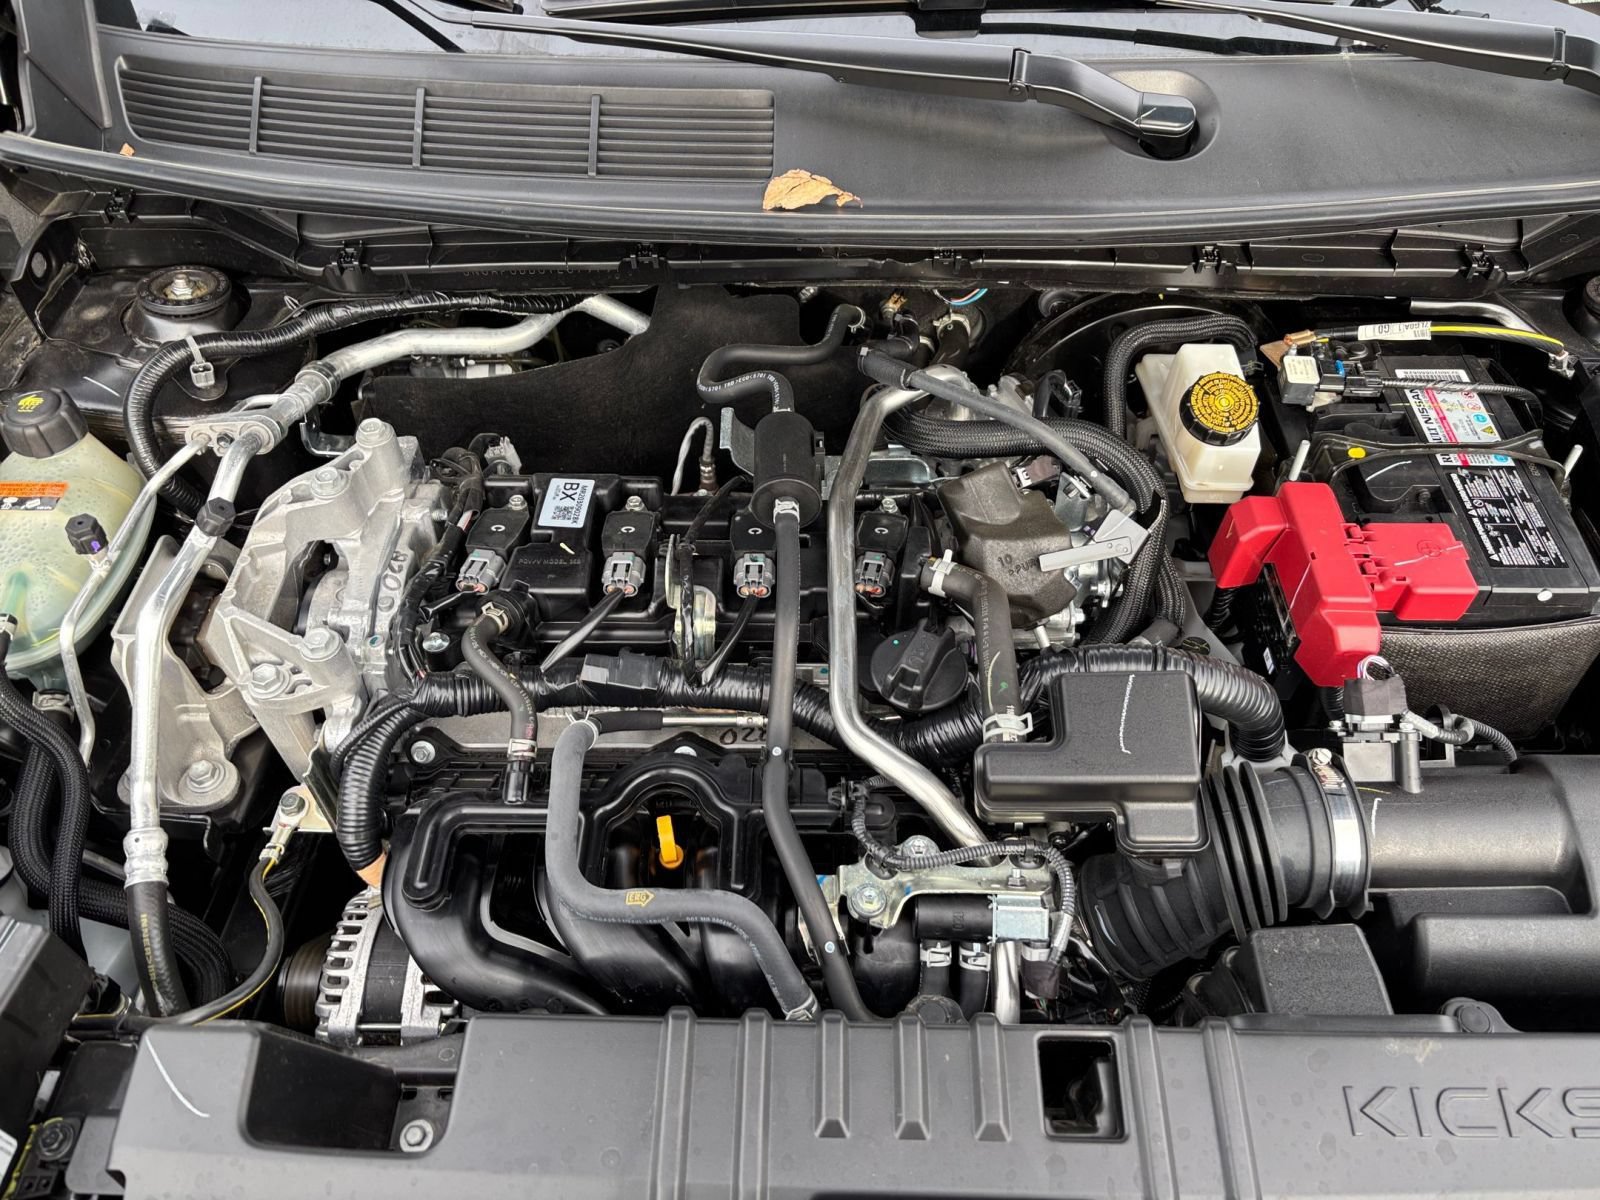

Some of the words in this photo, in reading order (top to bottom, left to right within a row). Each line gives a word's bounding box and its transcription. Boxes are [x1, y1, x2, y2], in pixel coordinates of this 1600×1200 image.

[1427, 426, 1453, 463] RULT
[560, 482, 580, 501] BX
[1342, 1085, 1600, 1138] KICKS
